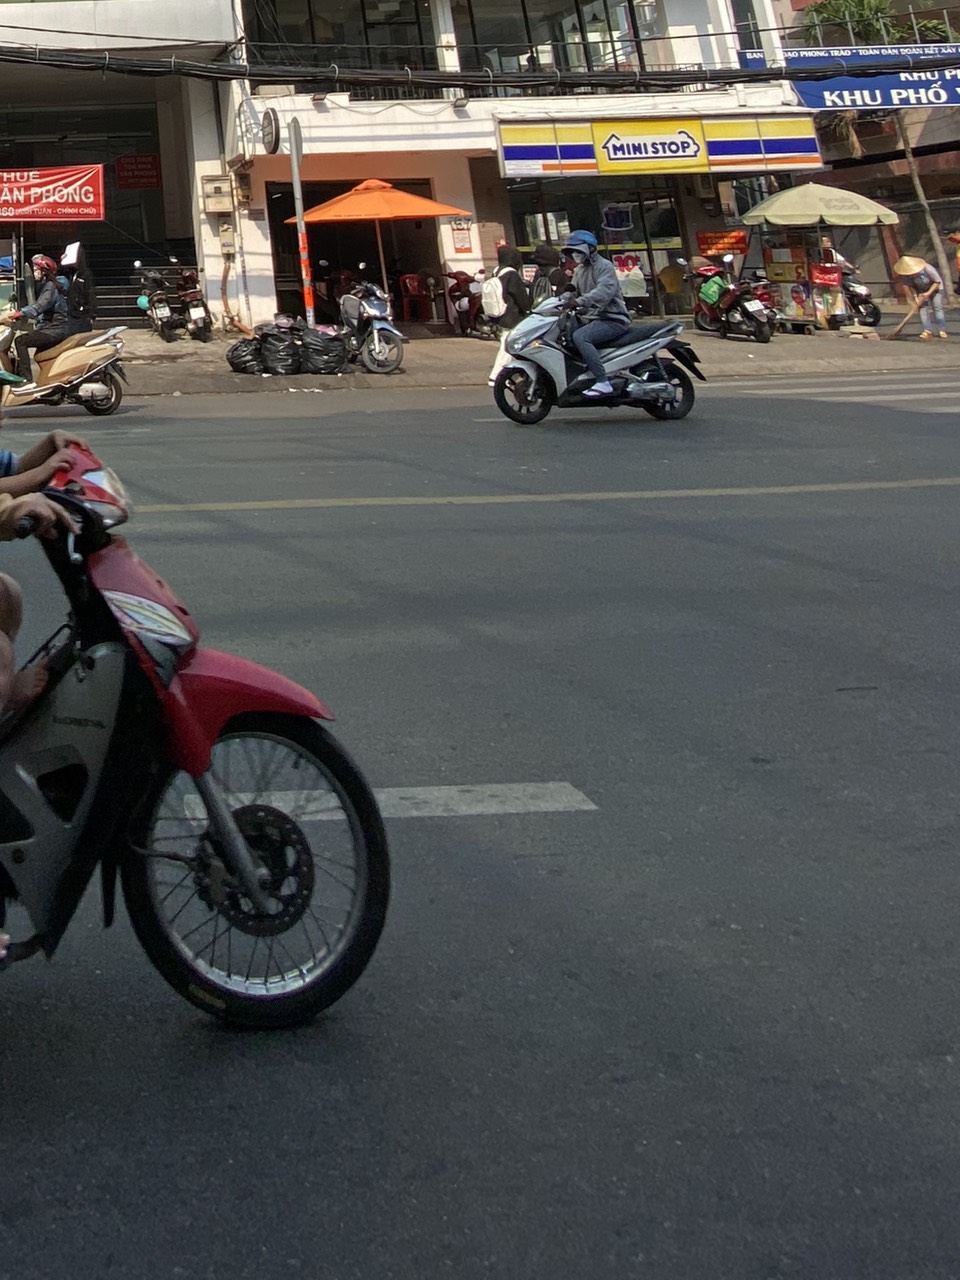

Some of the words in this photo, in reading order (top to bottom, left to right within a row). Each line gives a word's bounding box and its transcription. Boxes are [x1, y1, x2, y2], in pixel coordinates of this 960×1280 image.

[822, 89, 882, 107] KHU
[889, 80, 948, 105] PHỐ
[611, 142, 649, 156] MINI
[651, 140, 691, 155] STOP
